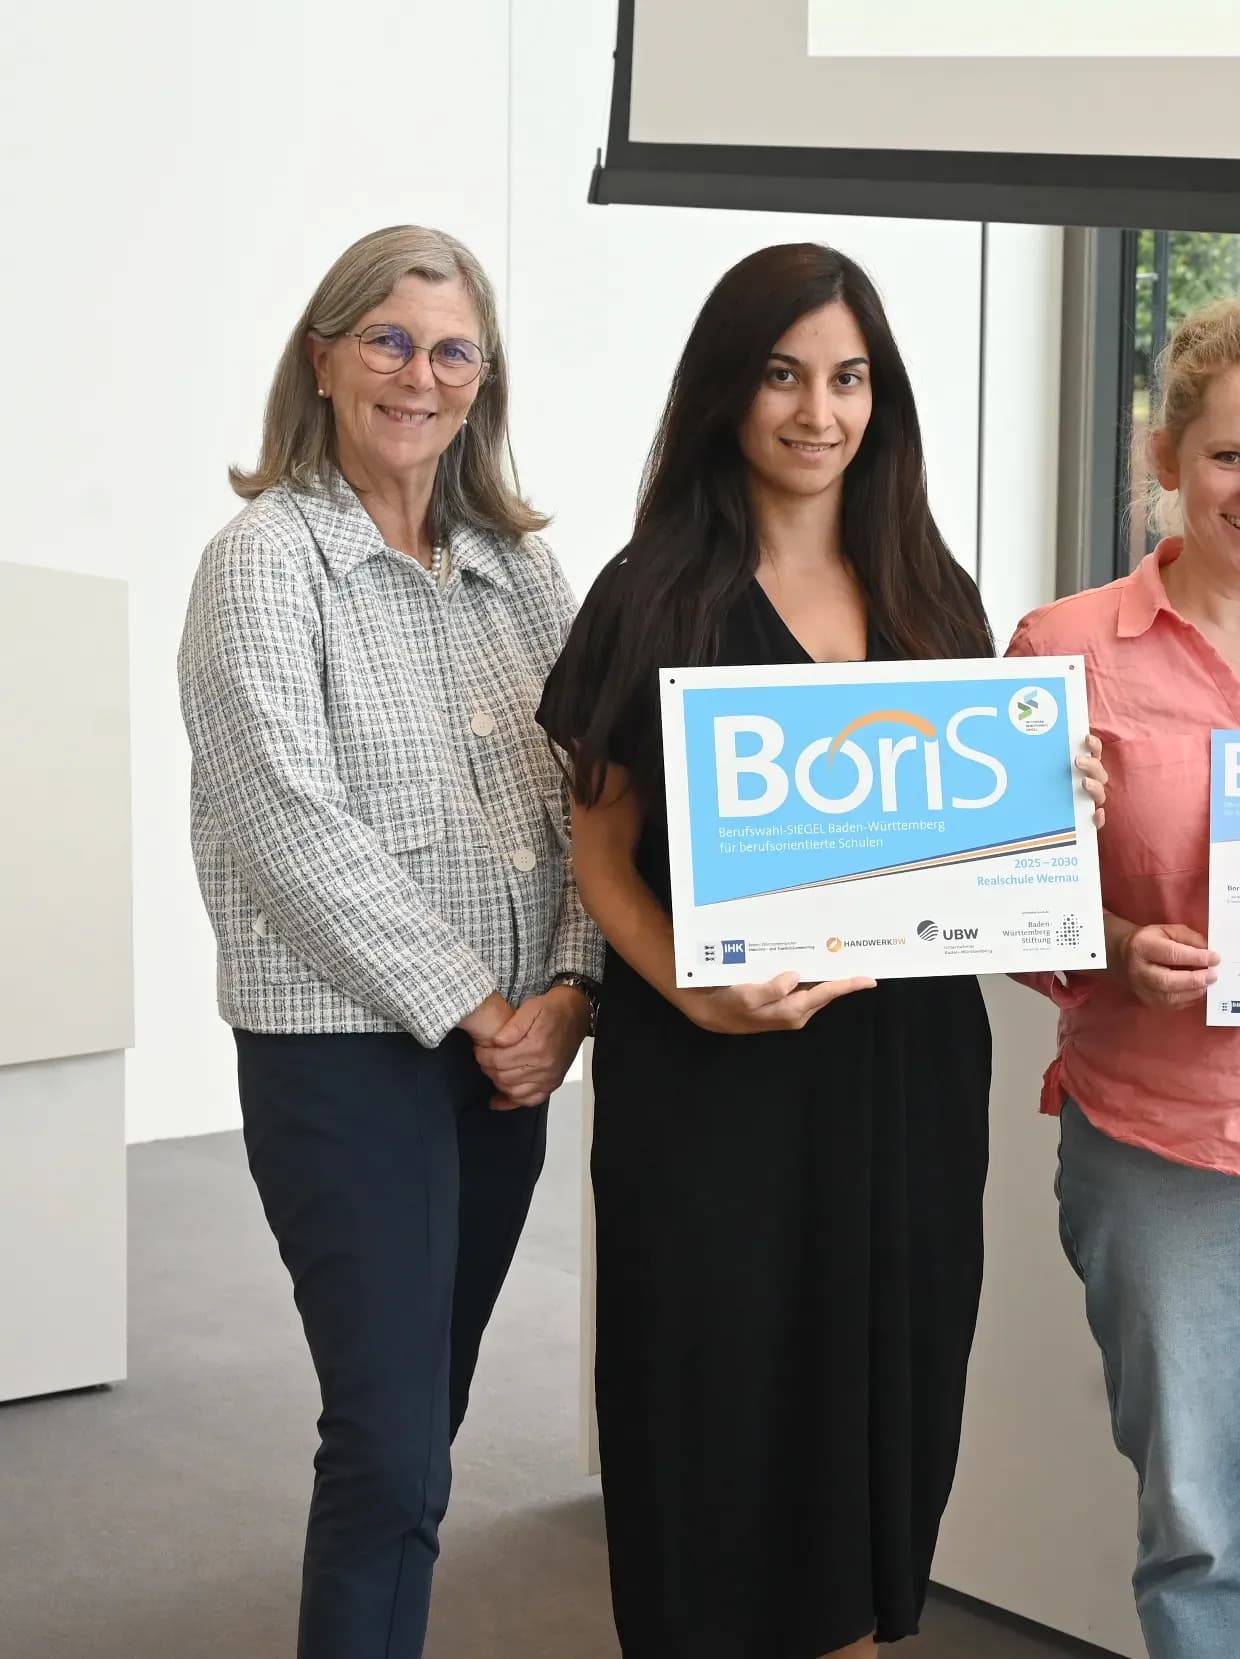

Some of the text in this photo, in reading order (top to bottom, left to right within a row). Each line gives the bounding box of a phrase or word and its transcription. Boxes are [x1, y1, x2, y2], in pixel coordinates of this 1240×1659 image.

[713, 706, 1008, 818] BoriS
[719, 820, 946, 838] Berufswahl-SIEGEL Baden-Württemberg
[719, 837, 884, 853] für berufsorientierte Schulen
[977, 873, 1079, 886] Realschule Wernau
[943, 928, 979, 940] UBW
[724, 943, 744, 953] IHK
